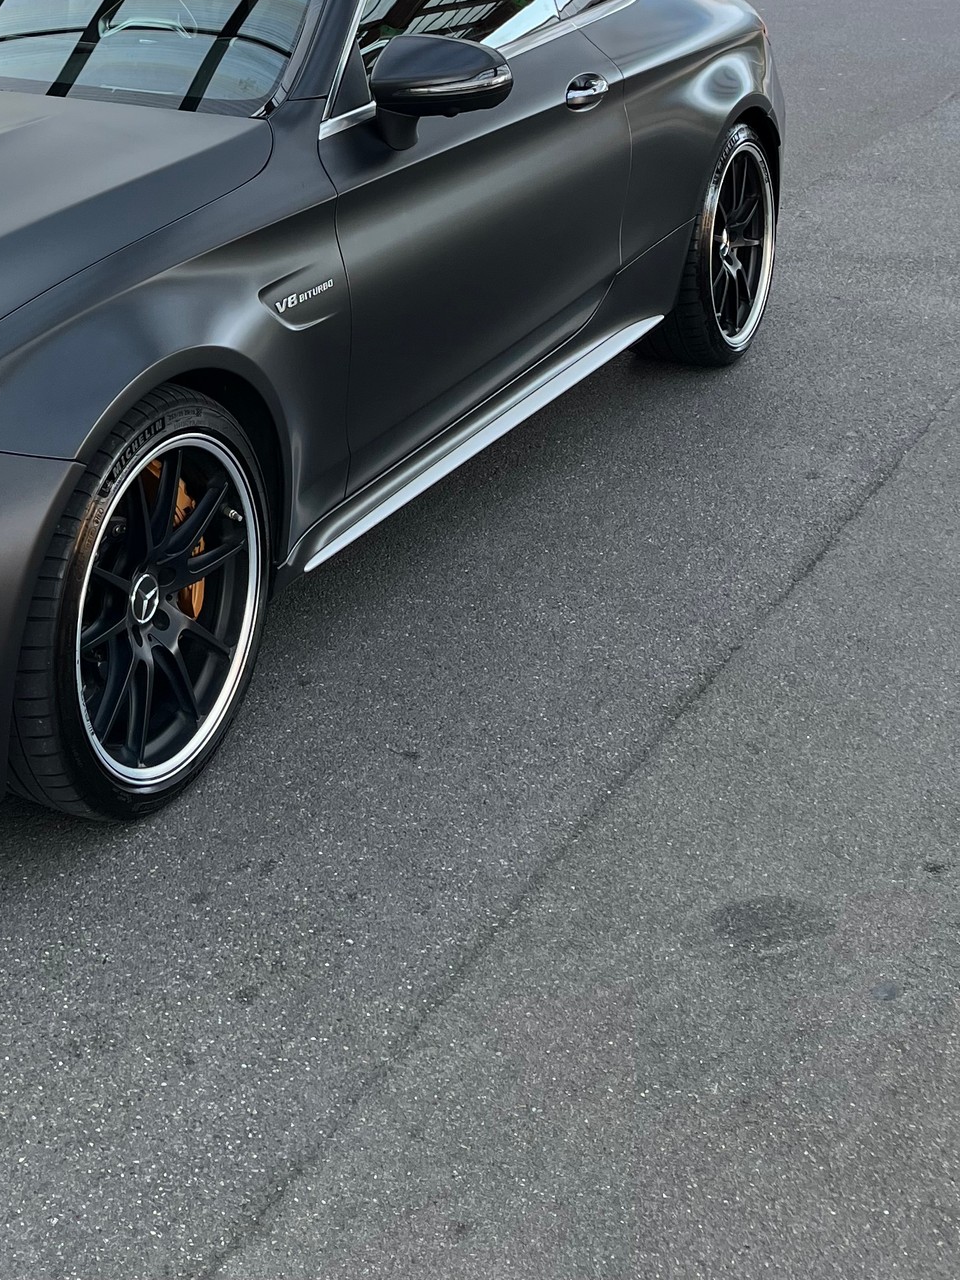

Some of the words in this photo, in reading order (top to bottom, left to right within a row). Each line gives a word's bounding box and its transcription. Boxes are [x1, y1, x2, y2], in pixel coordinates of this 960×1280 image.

[275, 293, 298, 313] V8
[299, 279, 334, 303] BITURBO
[112, 418, 165, 480] MICHELIN
